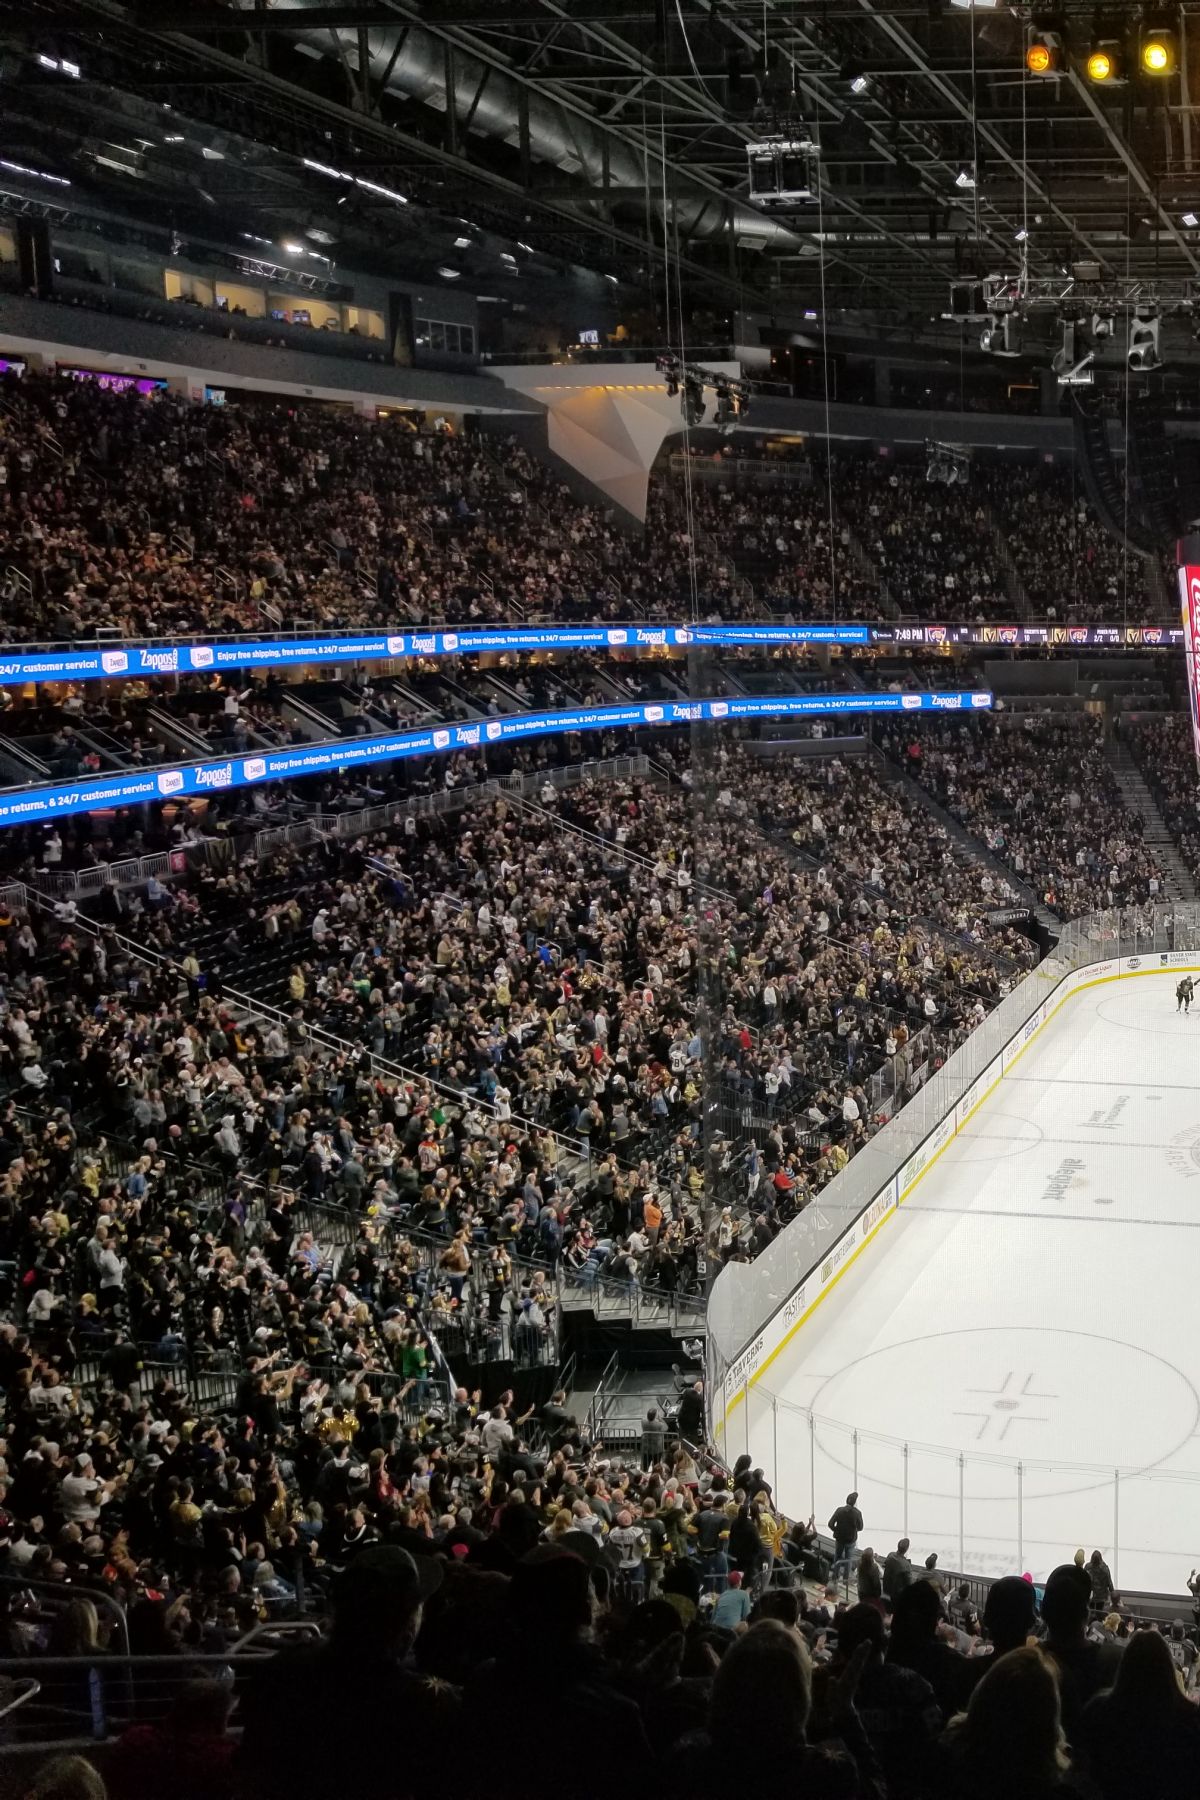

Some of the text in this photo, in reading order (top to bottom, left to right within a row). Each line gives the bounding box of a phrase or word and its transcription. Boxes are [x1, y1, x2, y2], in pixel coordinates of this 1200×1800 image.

[895, 629, 922, 640] 7:49 PM
[0, 659, 97, 674] 24/7 customer service!
[217, 651, 236, 660] Enjoy
[252, 649, 280, 658] shipping,
[295, 647, 317, 655] returns,
[323, 645, 337, 653] 24/7
[364, 642, 384, 650] service!
[270, 761, 287, 770] Enjoy
[289, 759, 301, 767] free
[303, 754, 330, 764] shipping,
[331, 752, 343, 760] free
[344, 749, 366, 758] returns,
[372, 744, 385, 753] 24/7
[386, 742, 410, 751] customer
[411, 738, 430, 747] service!
[10, 801, 47, 813] returns,
[48, 797, 55, 806] &
[57, 793, 79, 805] 24/7
[80, 788, 120, 801] customer
[122, 781, 153, 794] service!
[1041, 1158, 1086, 1200] allegiant
[733, 1336, 764, 1378] TAVERNS
